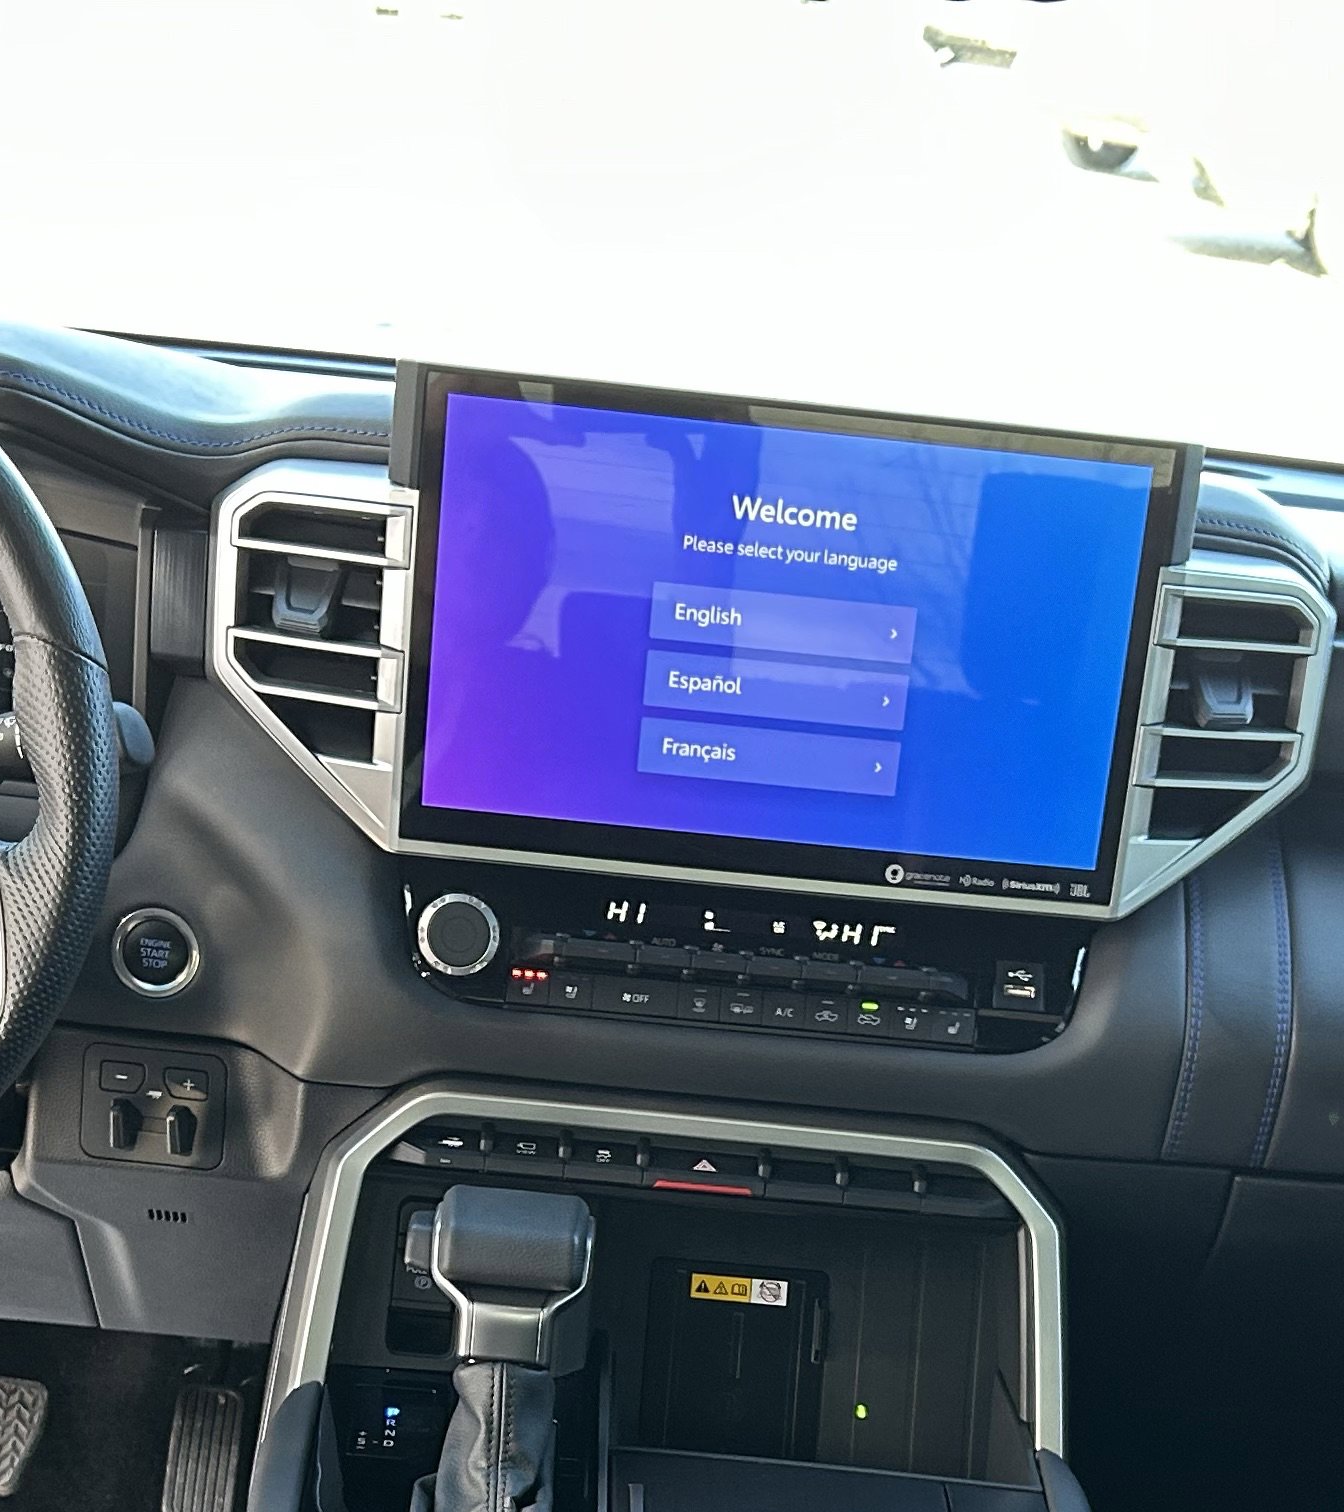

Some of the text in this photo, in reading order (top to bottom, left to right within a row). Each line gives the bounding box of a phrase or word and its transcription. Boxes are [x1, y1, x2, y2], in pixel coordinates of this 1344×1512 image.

[732, 494, 858, 532] Welcome
[682, 534, 898, 573] Please select your language
[673, 602, 742, 628] English
[667, 670, 743, 697] Español
[661, 737, 736, 764] Français
[905, 870, 950, 882] gracenote
[972, 876, 995, 887] Radio
[1070, 884, 1090, 898] JBL
[140, 938, 171, 949] ENGINE
[651, 937, 676, 947] AUTO
[140, 948, 169, 959] START
[759, 946, 785, 957] SYNC
[142, 958, 168, 968] STOP
[632, 994, 649, 1004] OFF
[775, 1007, 794, 1018] A/C
[383, 1439, 395, 1447] D
